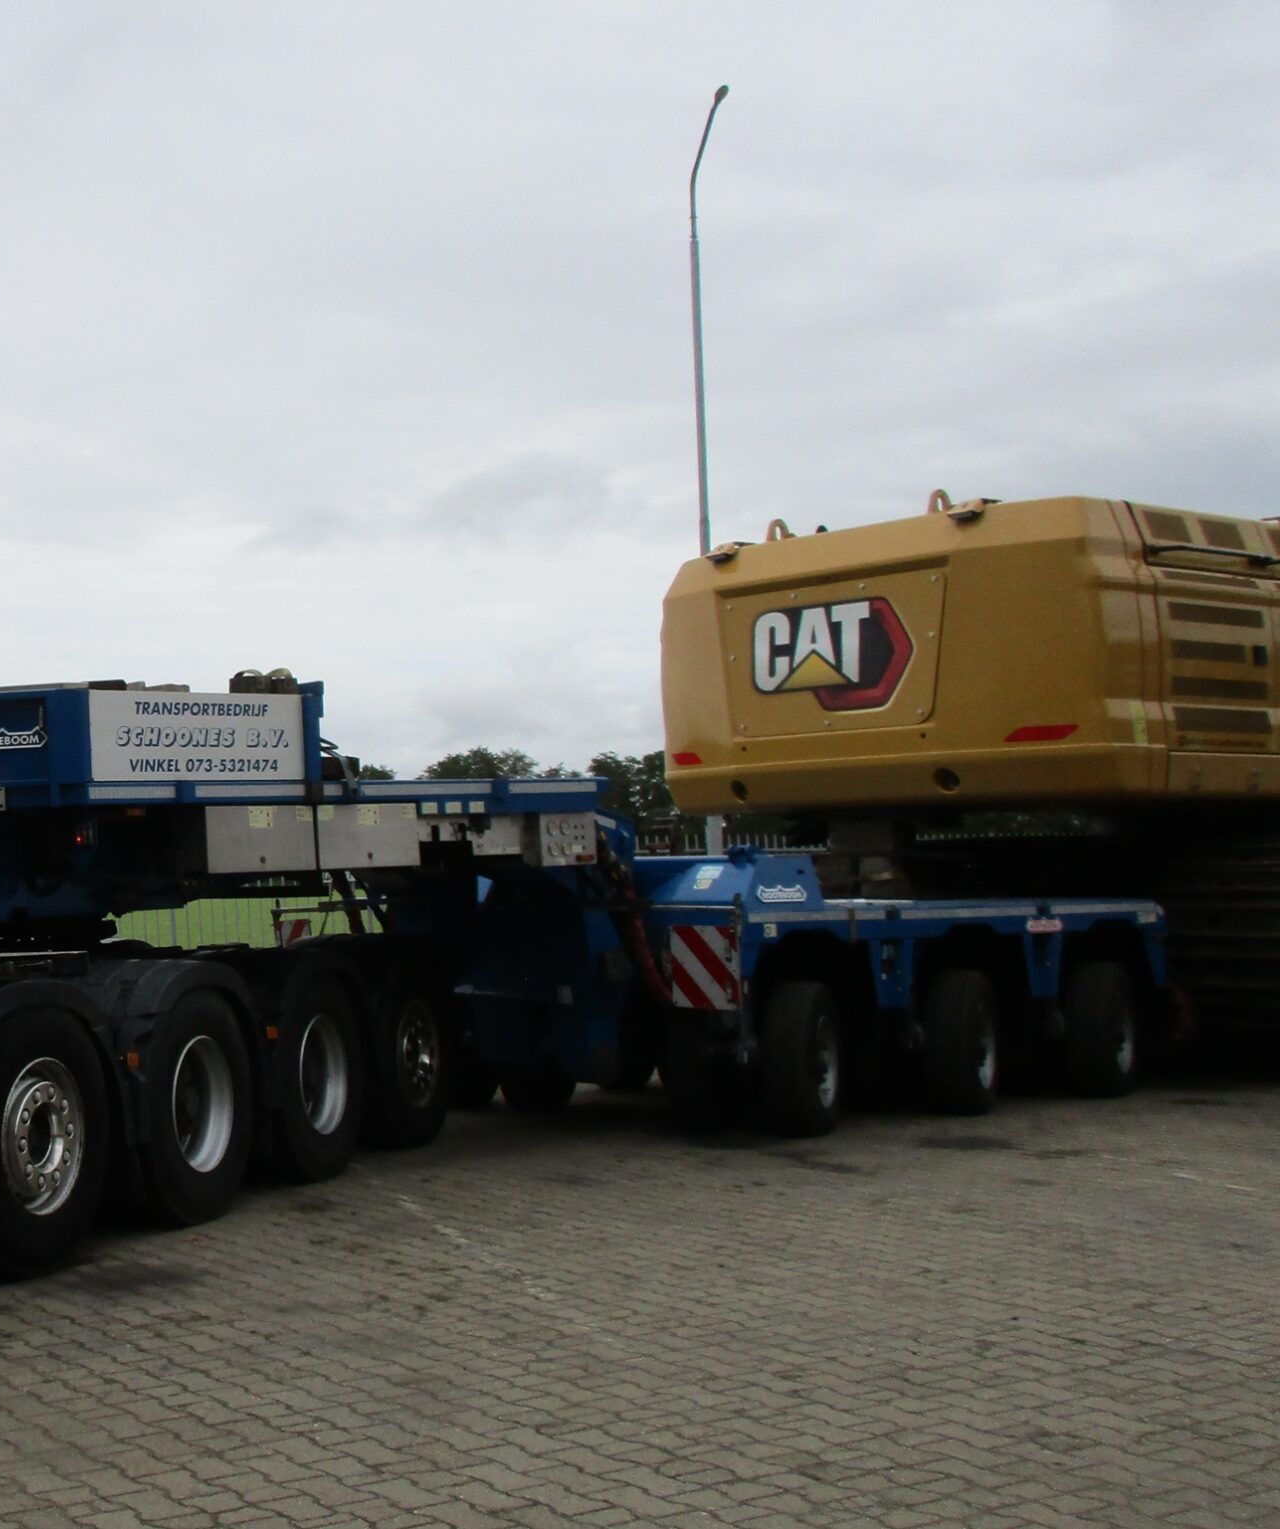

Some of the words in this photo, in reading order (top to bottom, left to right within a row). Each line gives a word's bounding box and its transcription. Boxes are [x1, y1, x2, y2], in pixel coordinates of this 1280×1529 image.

[754, 600, 870, 692] CAT
[134, 701, 269, 717] TRANSPORTBEDRIJF
[116, 726, 236, 748] SCHOONES
[246, 729, 290, 748] B.V.
[129, 758, 181, 773] VINKEL
[186, 758, 279, 773] 073-5321474
